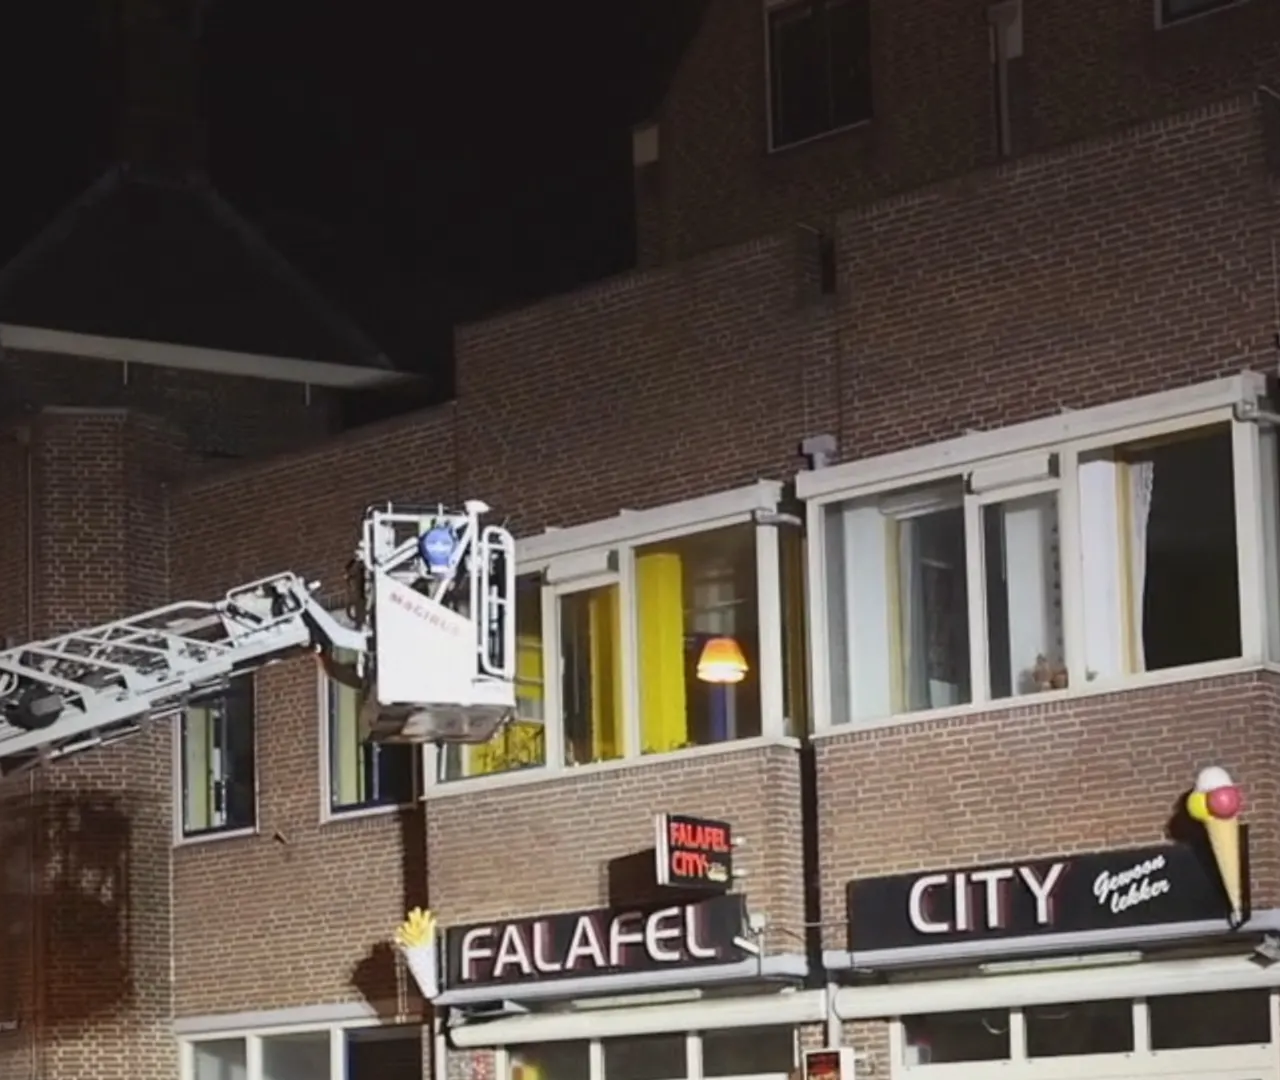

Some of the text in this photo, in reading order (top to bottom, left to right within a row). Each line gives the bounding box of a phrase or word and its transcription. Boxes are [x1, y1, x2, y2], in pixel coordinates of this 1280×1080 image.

[670, 822, 729, 852] FALAFEL
[672, 850, 708, 877] CITY
[1092, 854, 1166, 904] Gewoon
[908, 863, 1065, 934] CITY
[461, 904, 716, 980] FALAFEL
